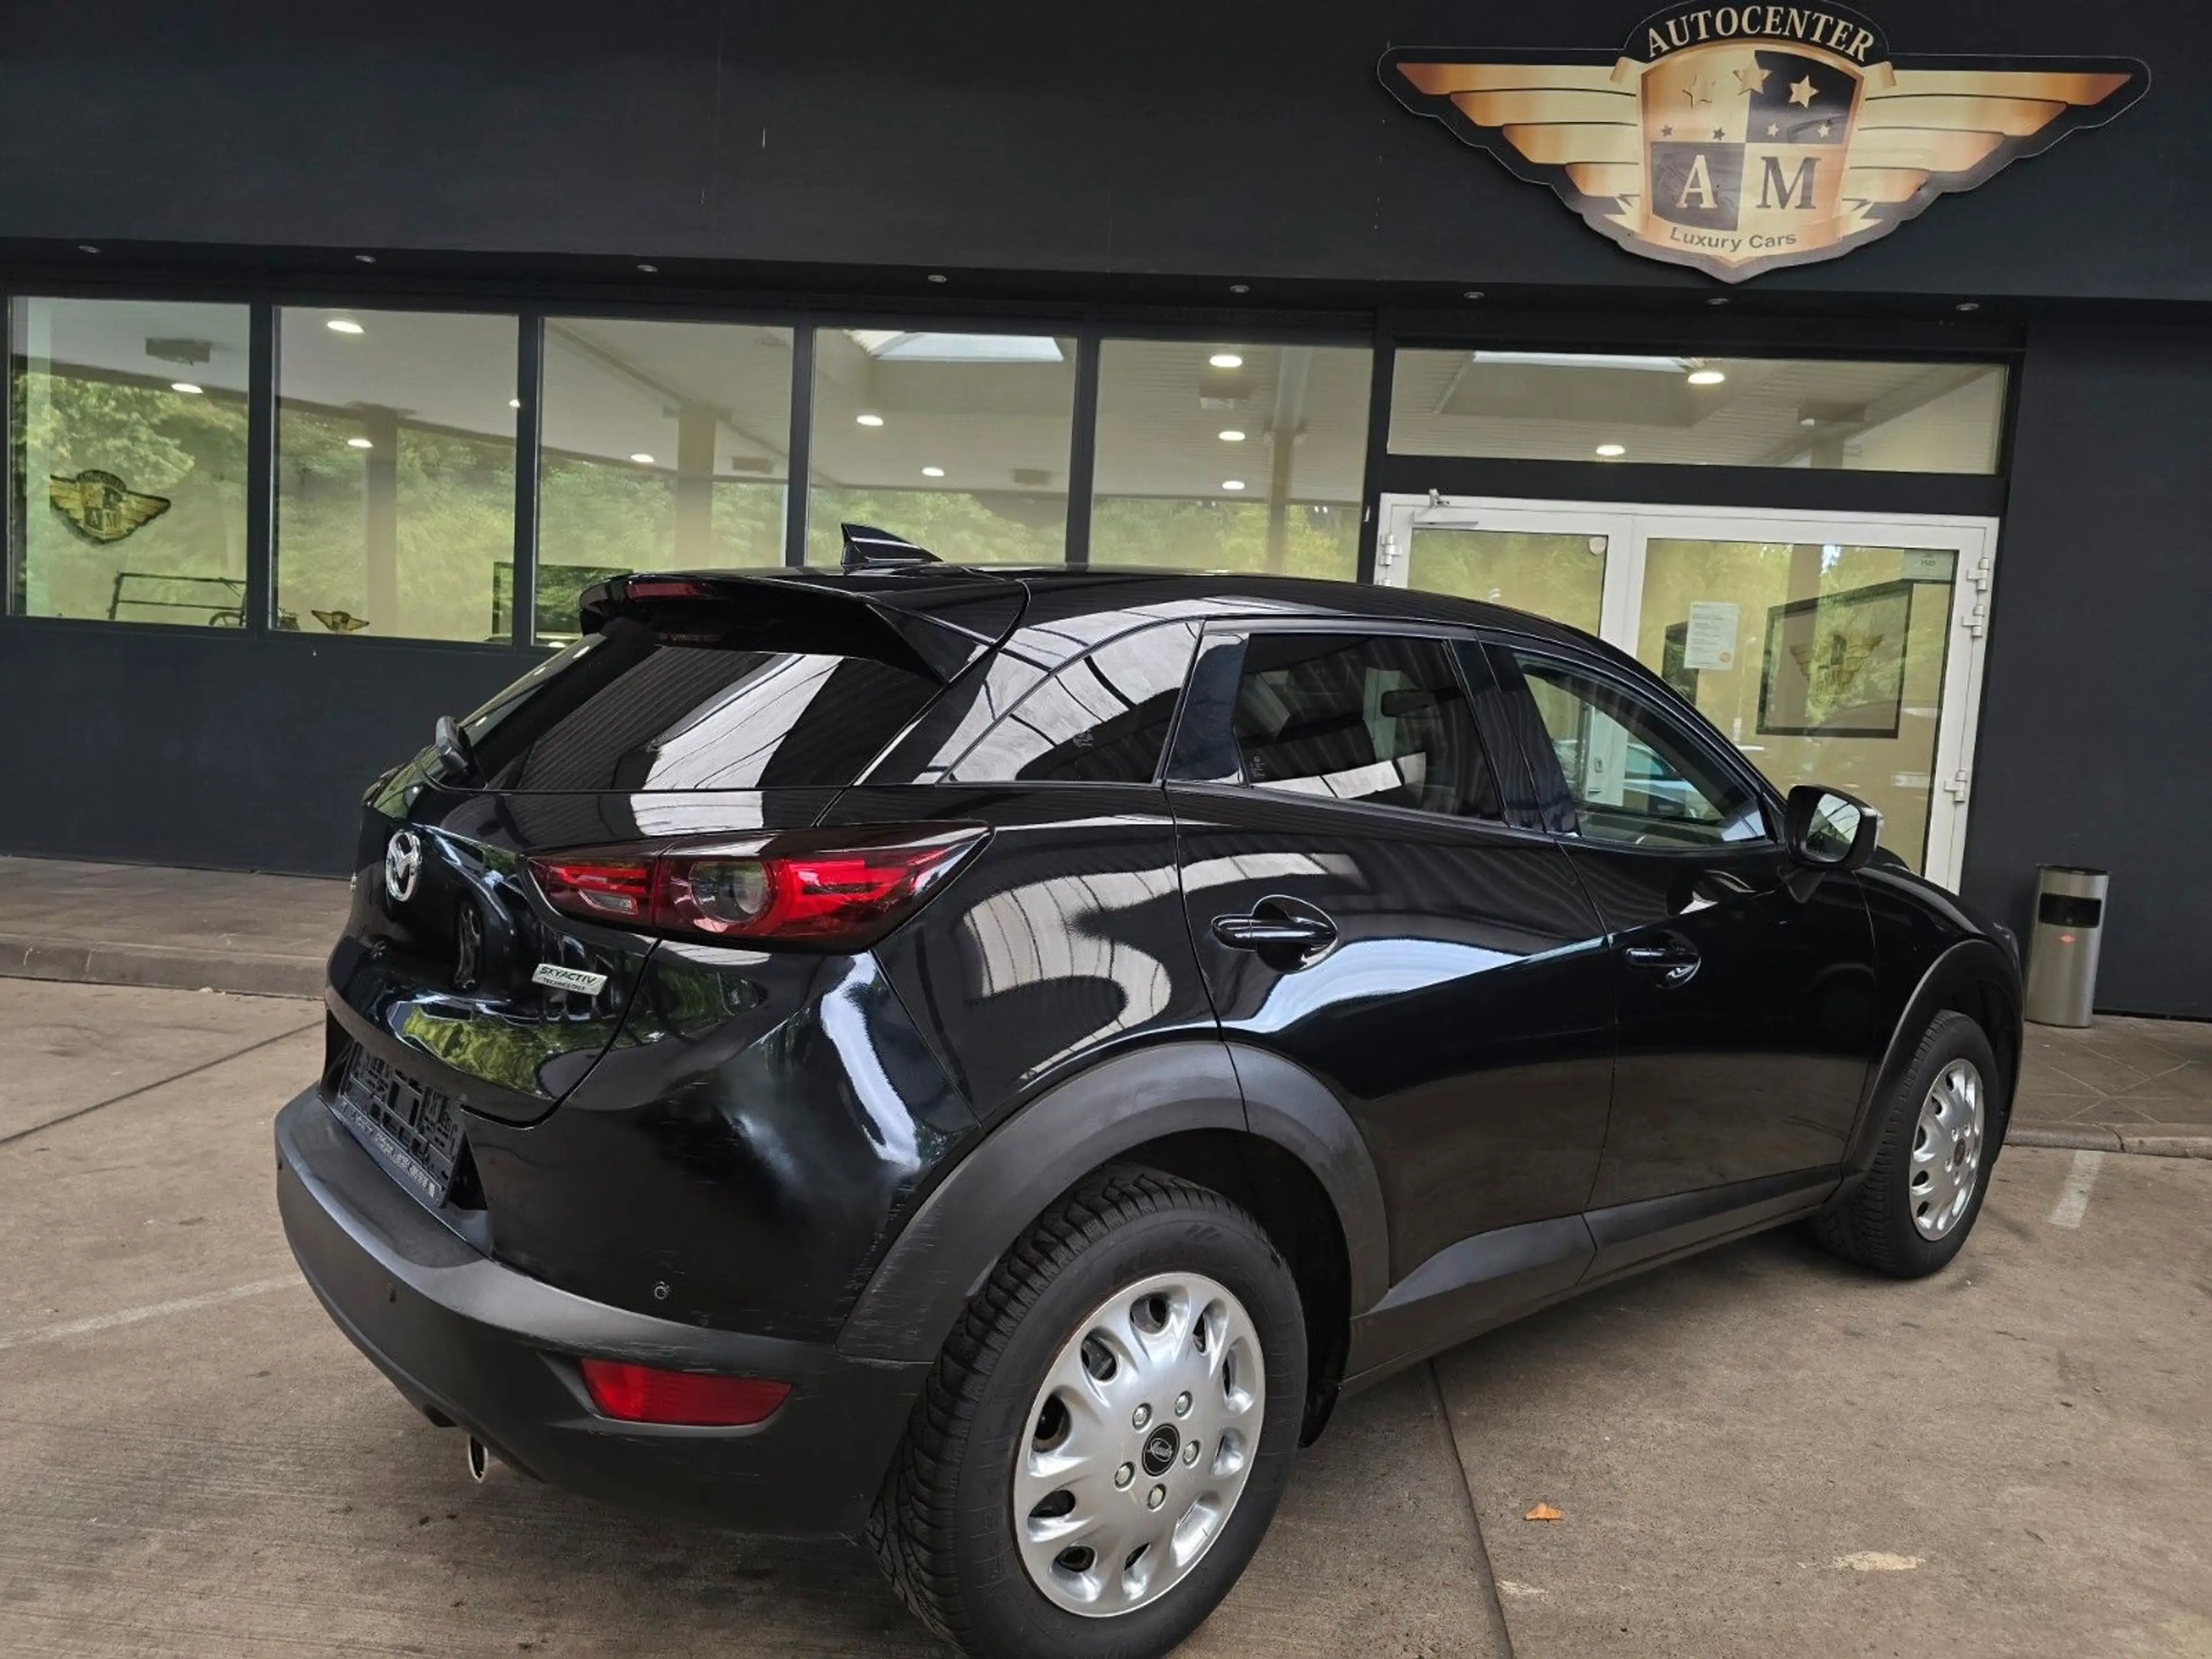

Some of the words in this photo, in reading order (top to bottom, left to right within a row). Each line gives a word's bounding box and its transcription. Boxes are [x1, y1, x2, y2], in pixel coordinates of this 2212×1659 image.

[1648, 5, 1874, 62] AUTOCENTER
[1676, 154, 1718, 209] A
[1756, 156, 1821, 209] M
[1669, 226, 1741, 252] Luxury
[1749, 233, 1797, 249] Cars
[540, 967, 597, 984] SKYACTIV
